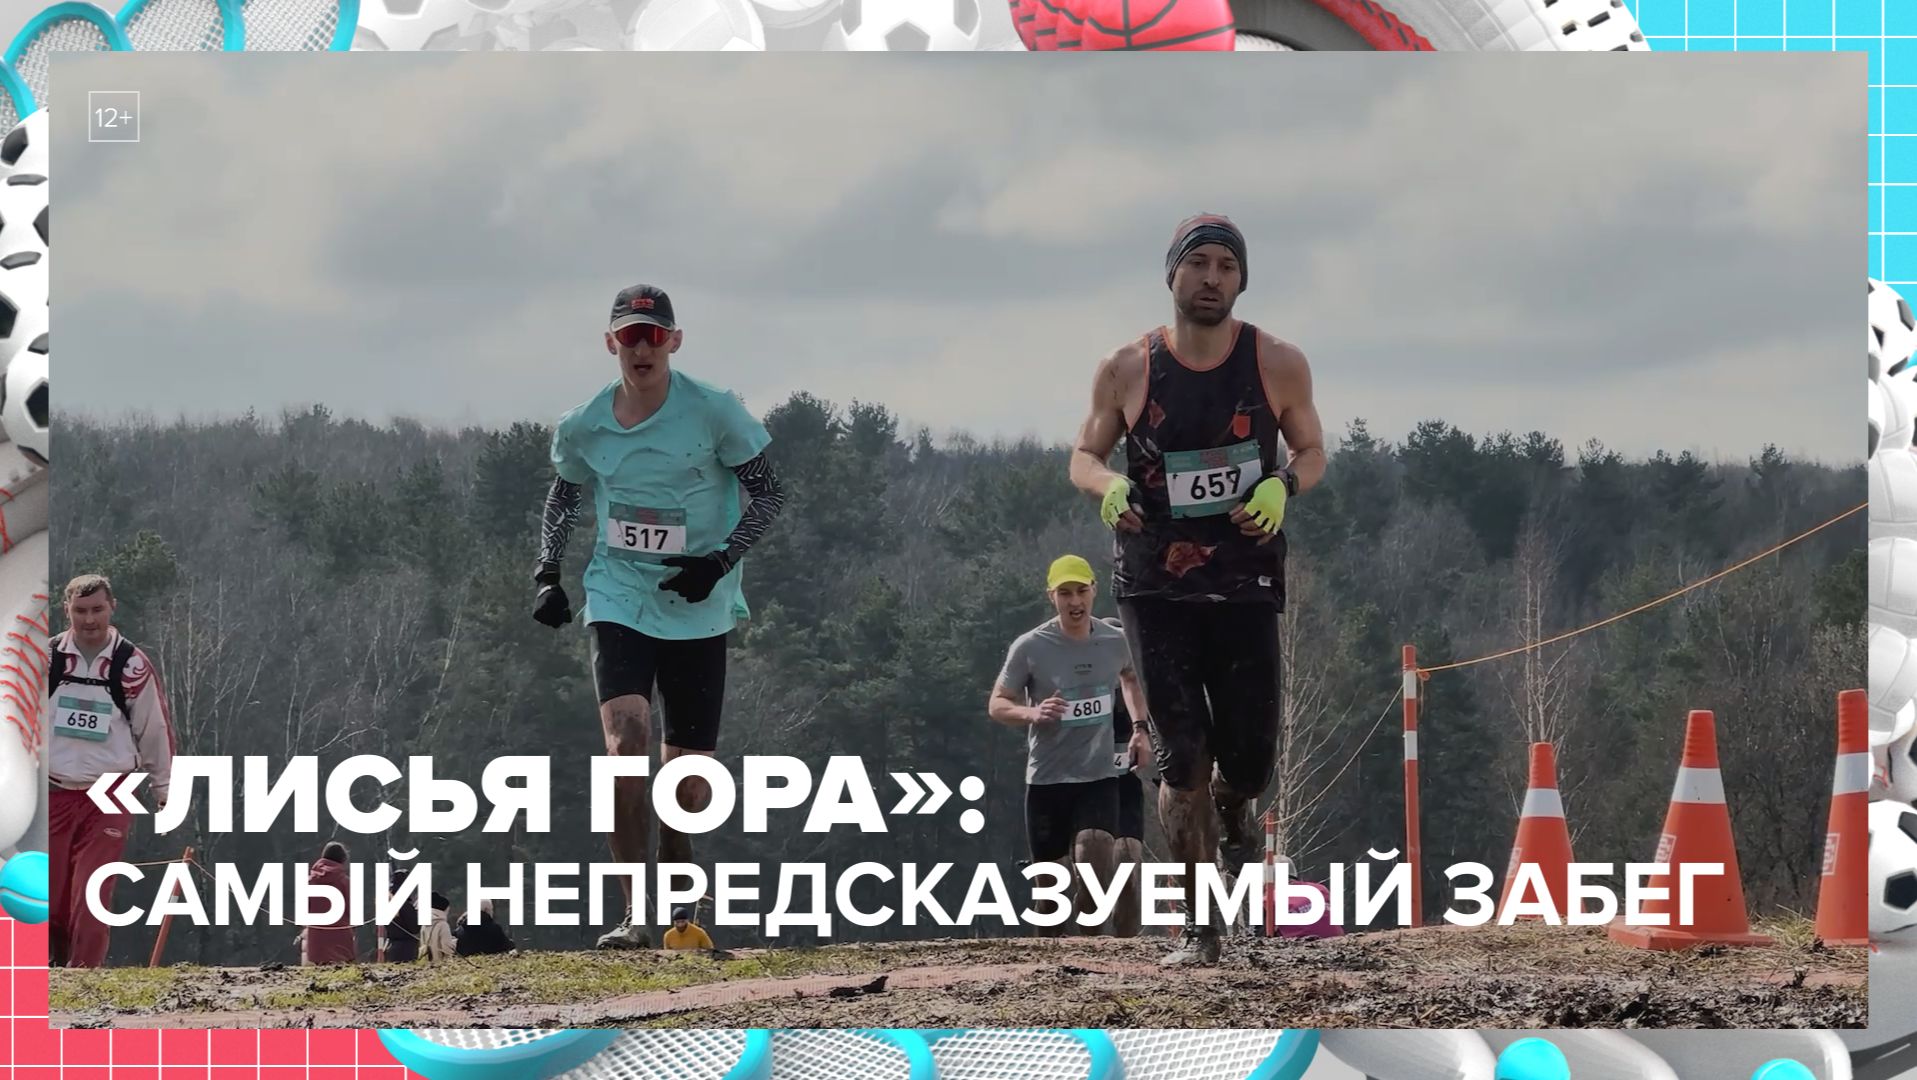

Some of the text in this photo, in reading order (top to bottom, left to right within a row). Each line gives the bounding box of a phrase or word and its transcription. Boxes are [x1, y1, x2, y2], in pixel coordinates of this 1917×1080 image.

[625, 525, 669, 550] 517
[1073, 700, 1102, 717] 680
[67, 712, 98, 729] 658
